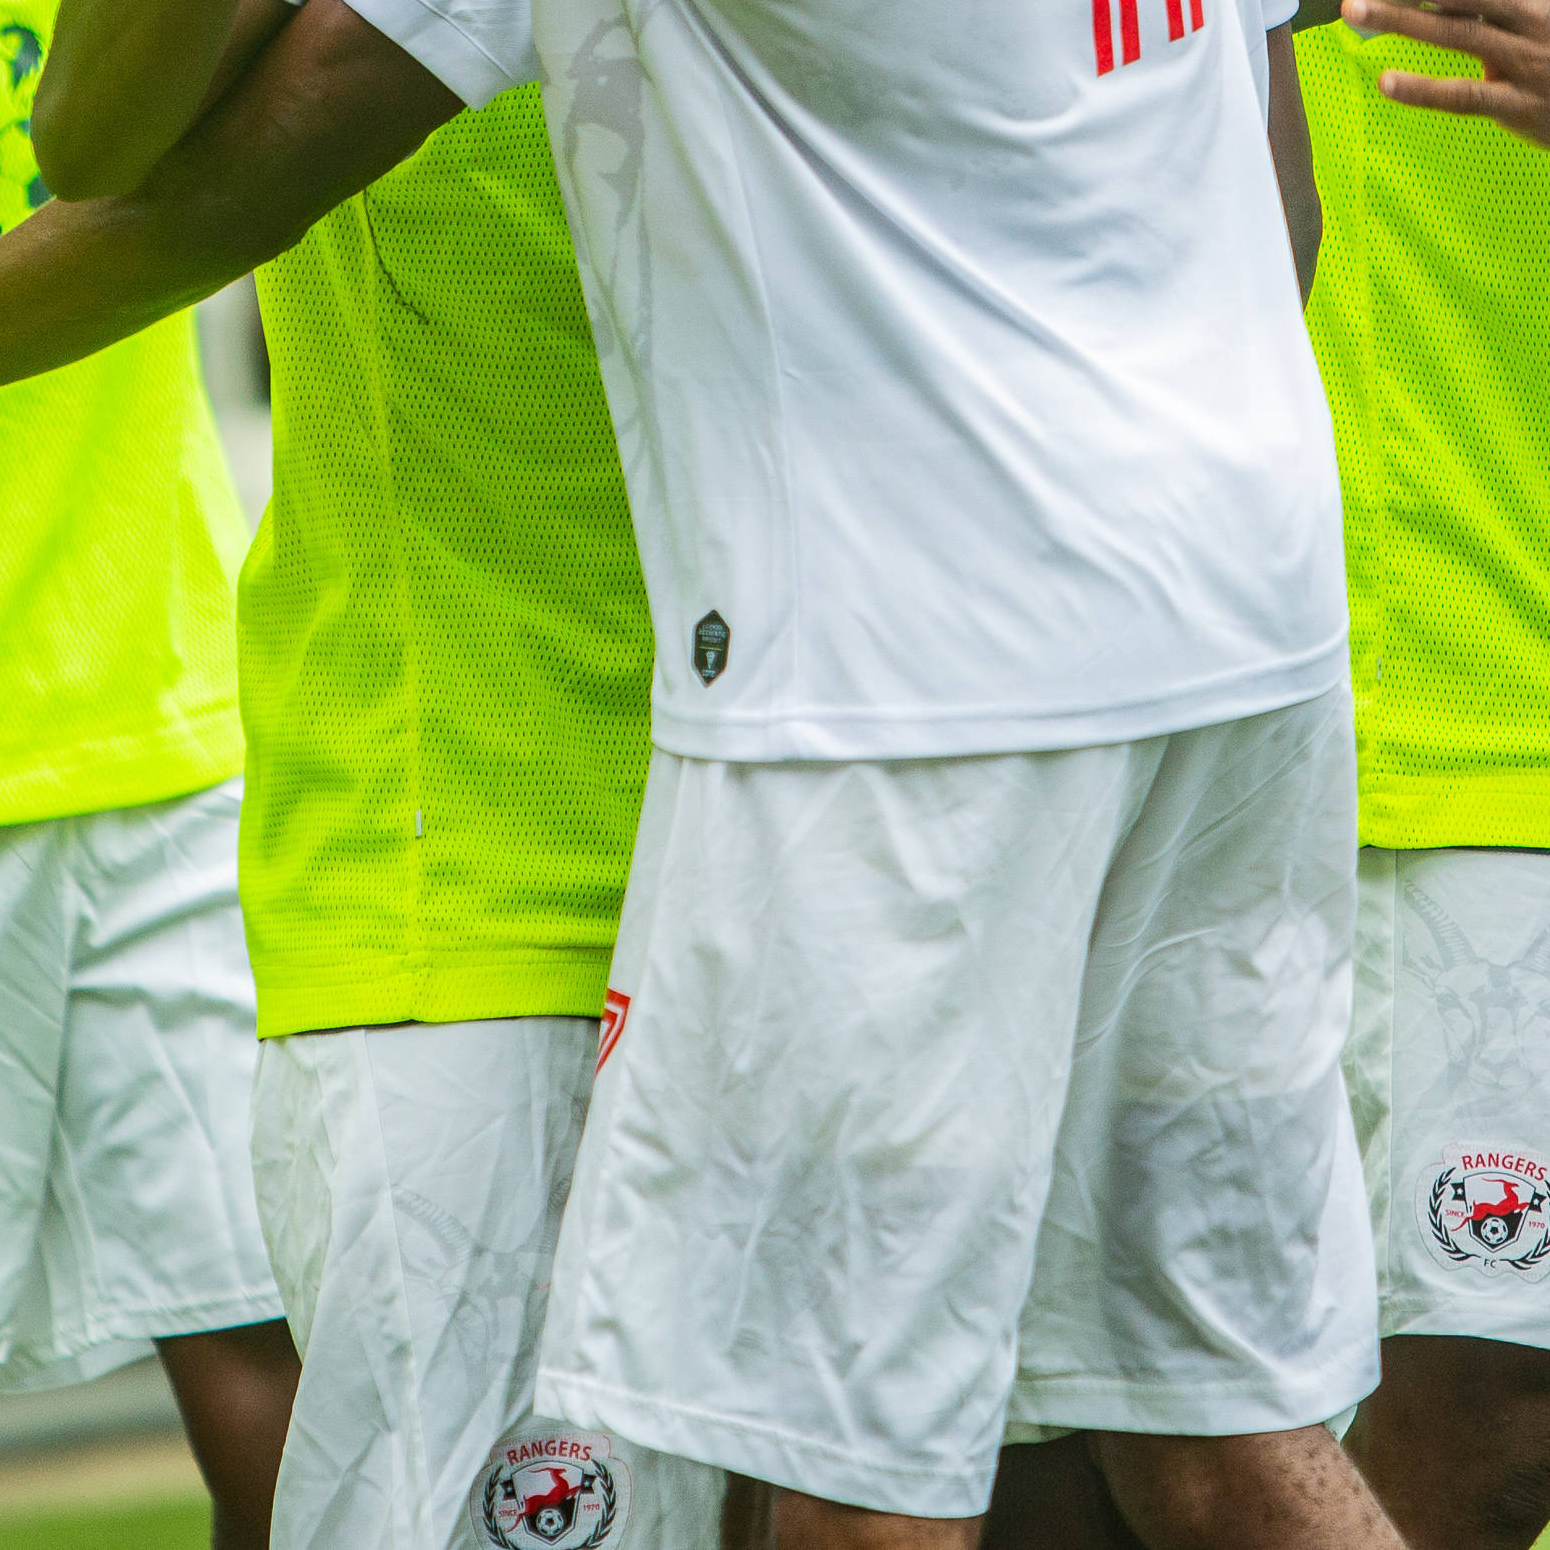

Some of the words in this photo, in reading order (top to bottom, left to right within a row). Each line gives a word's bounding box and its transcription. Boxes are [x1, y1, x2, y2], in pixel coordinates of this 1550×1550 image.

[1461, 1152, 1548, 1182] RANGERS
[1444, 1208, 1466, 1219] SINCE
[1528, 1220, 1546, 1230] 1970
[1483, 1258, 1497, 1269] FC
[506, 1439, 593, 1467] RANGERS
[498, 1508, 519, 1518] SINCE
[582, 1502, 601, 1511] 1970
